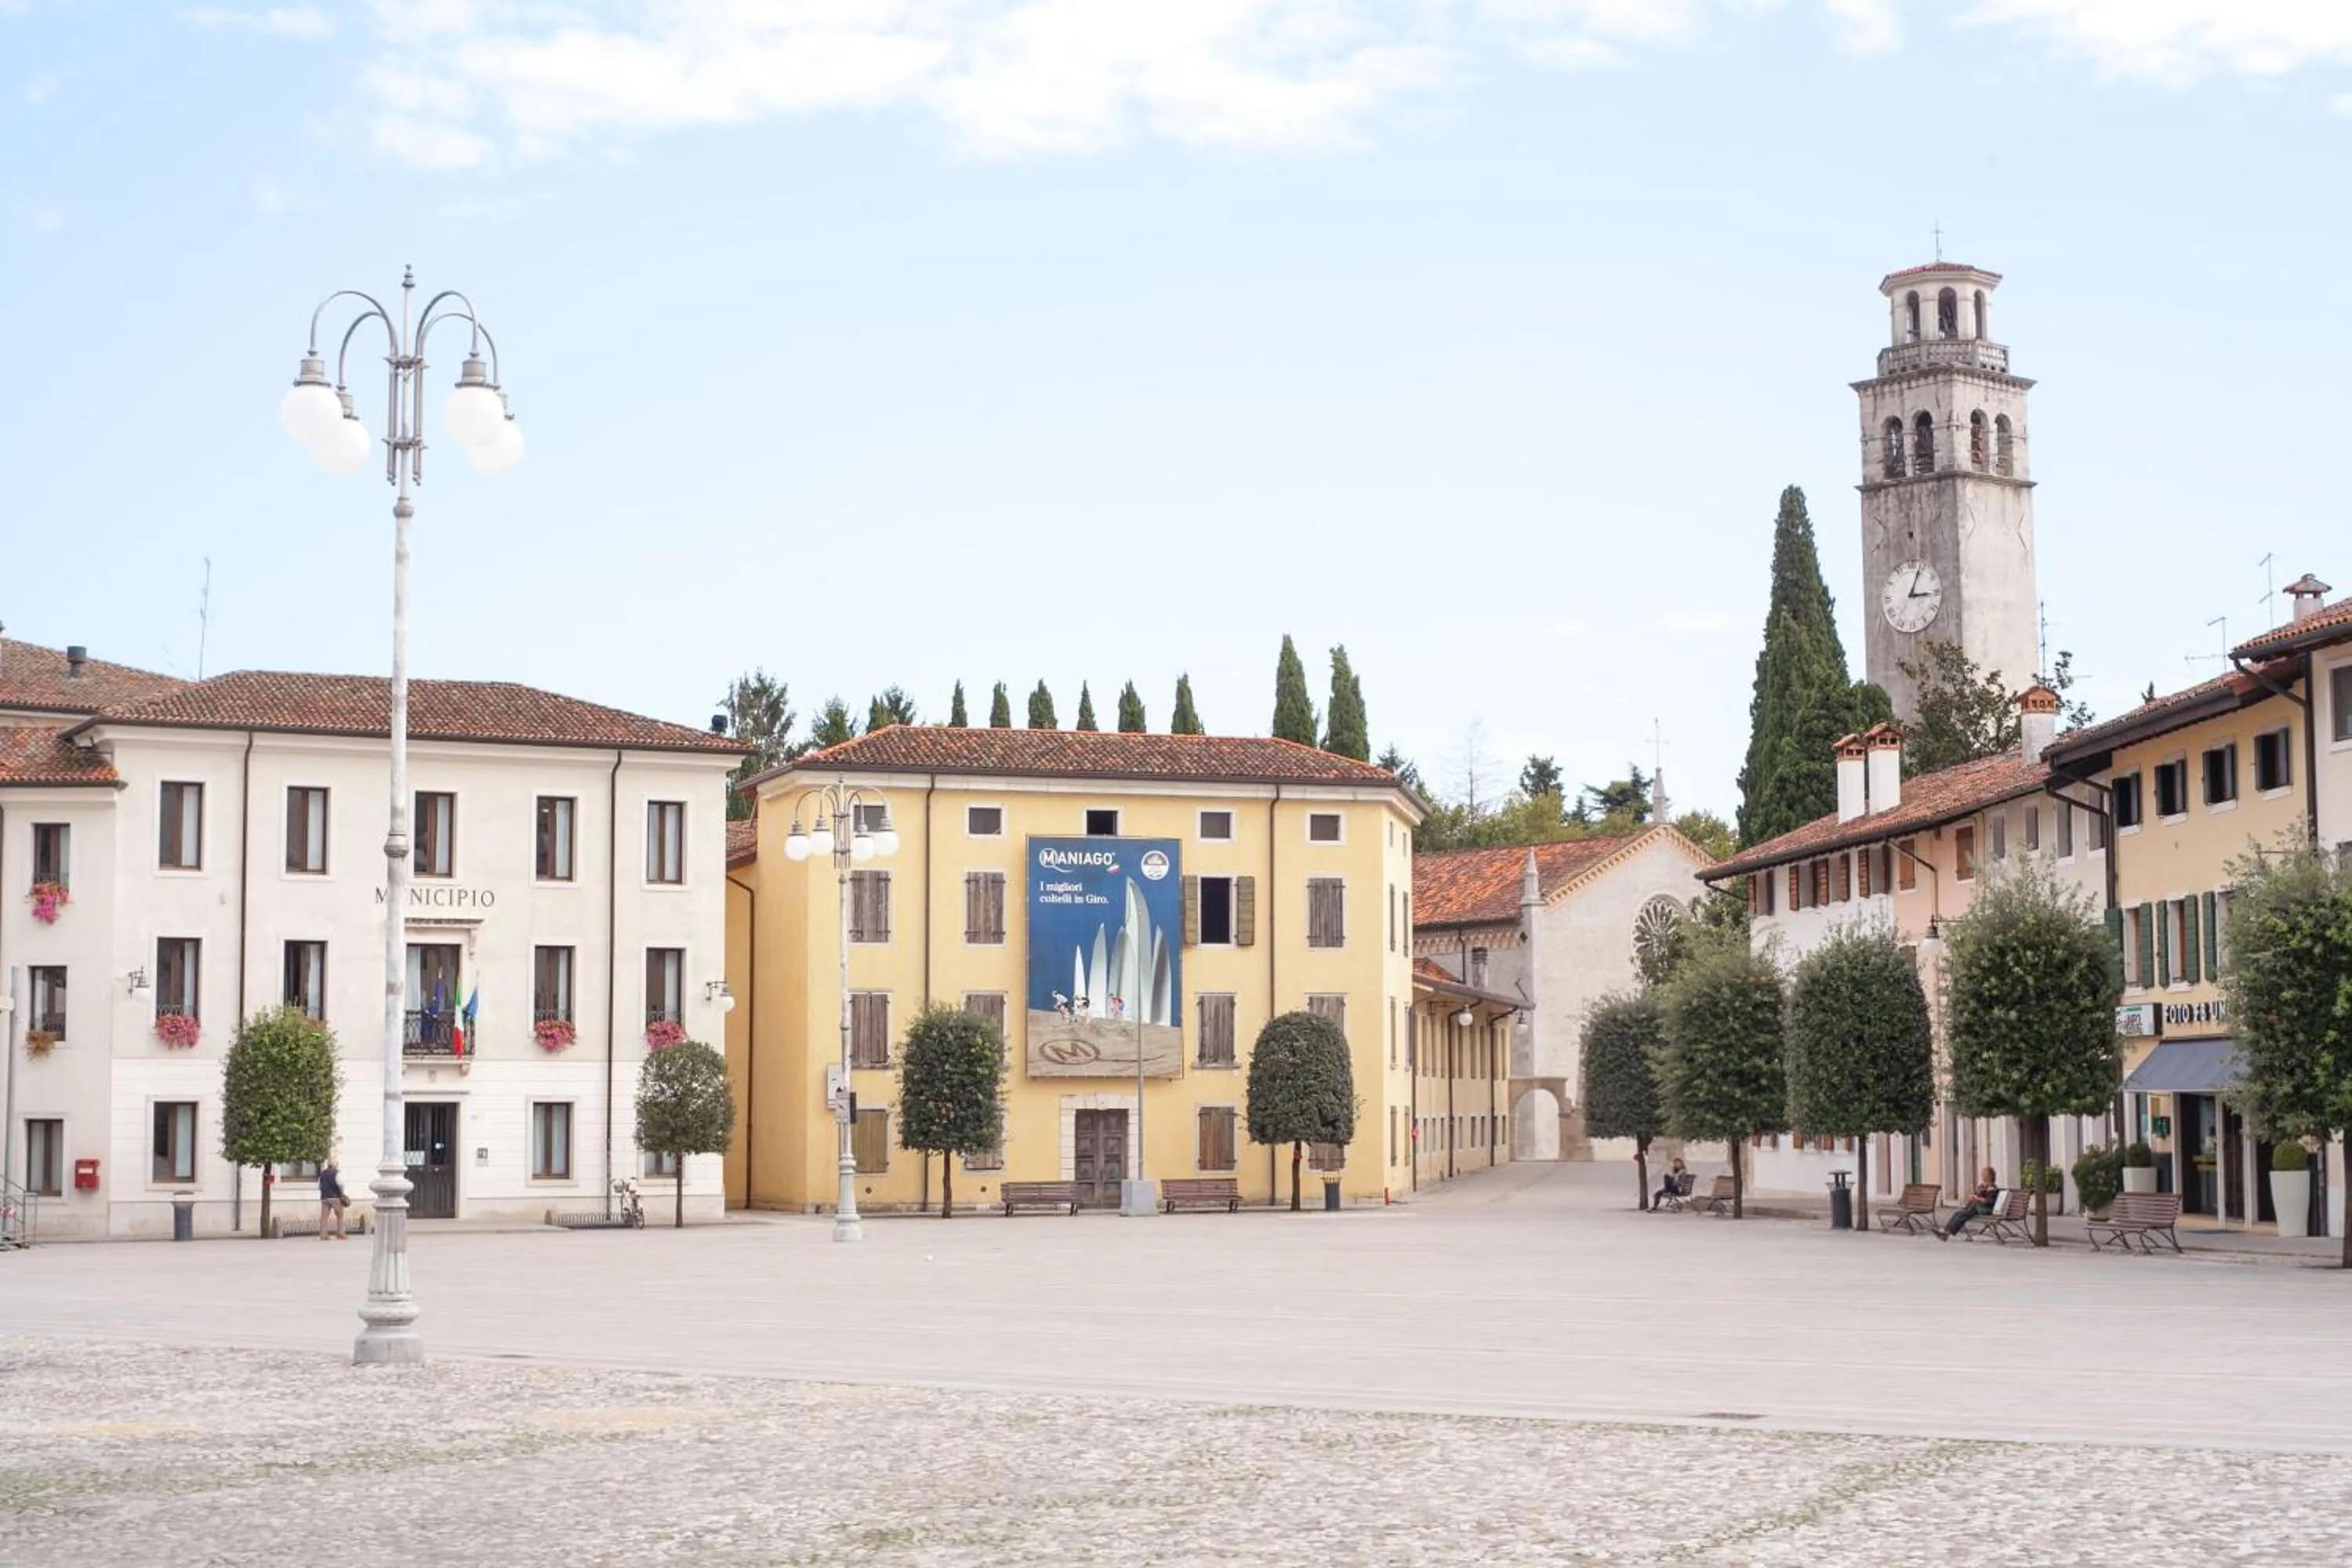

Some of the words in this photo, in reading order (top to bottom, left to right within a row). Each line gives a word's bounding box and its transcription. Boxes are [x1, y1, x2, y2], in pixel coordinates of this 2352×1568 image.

[1040, 848, 1114, 868] MANIAGO
[1046, 881, 1083, 893] migliori
[376, 886, 495, 907] MNICIPIO
[1039, 894, 1073, 904] coltelli
[1074, 895, 1084, 904] in
